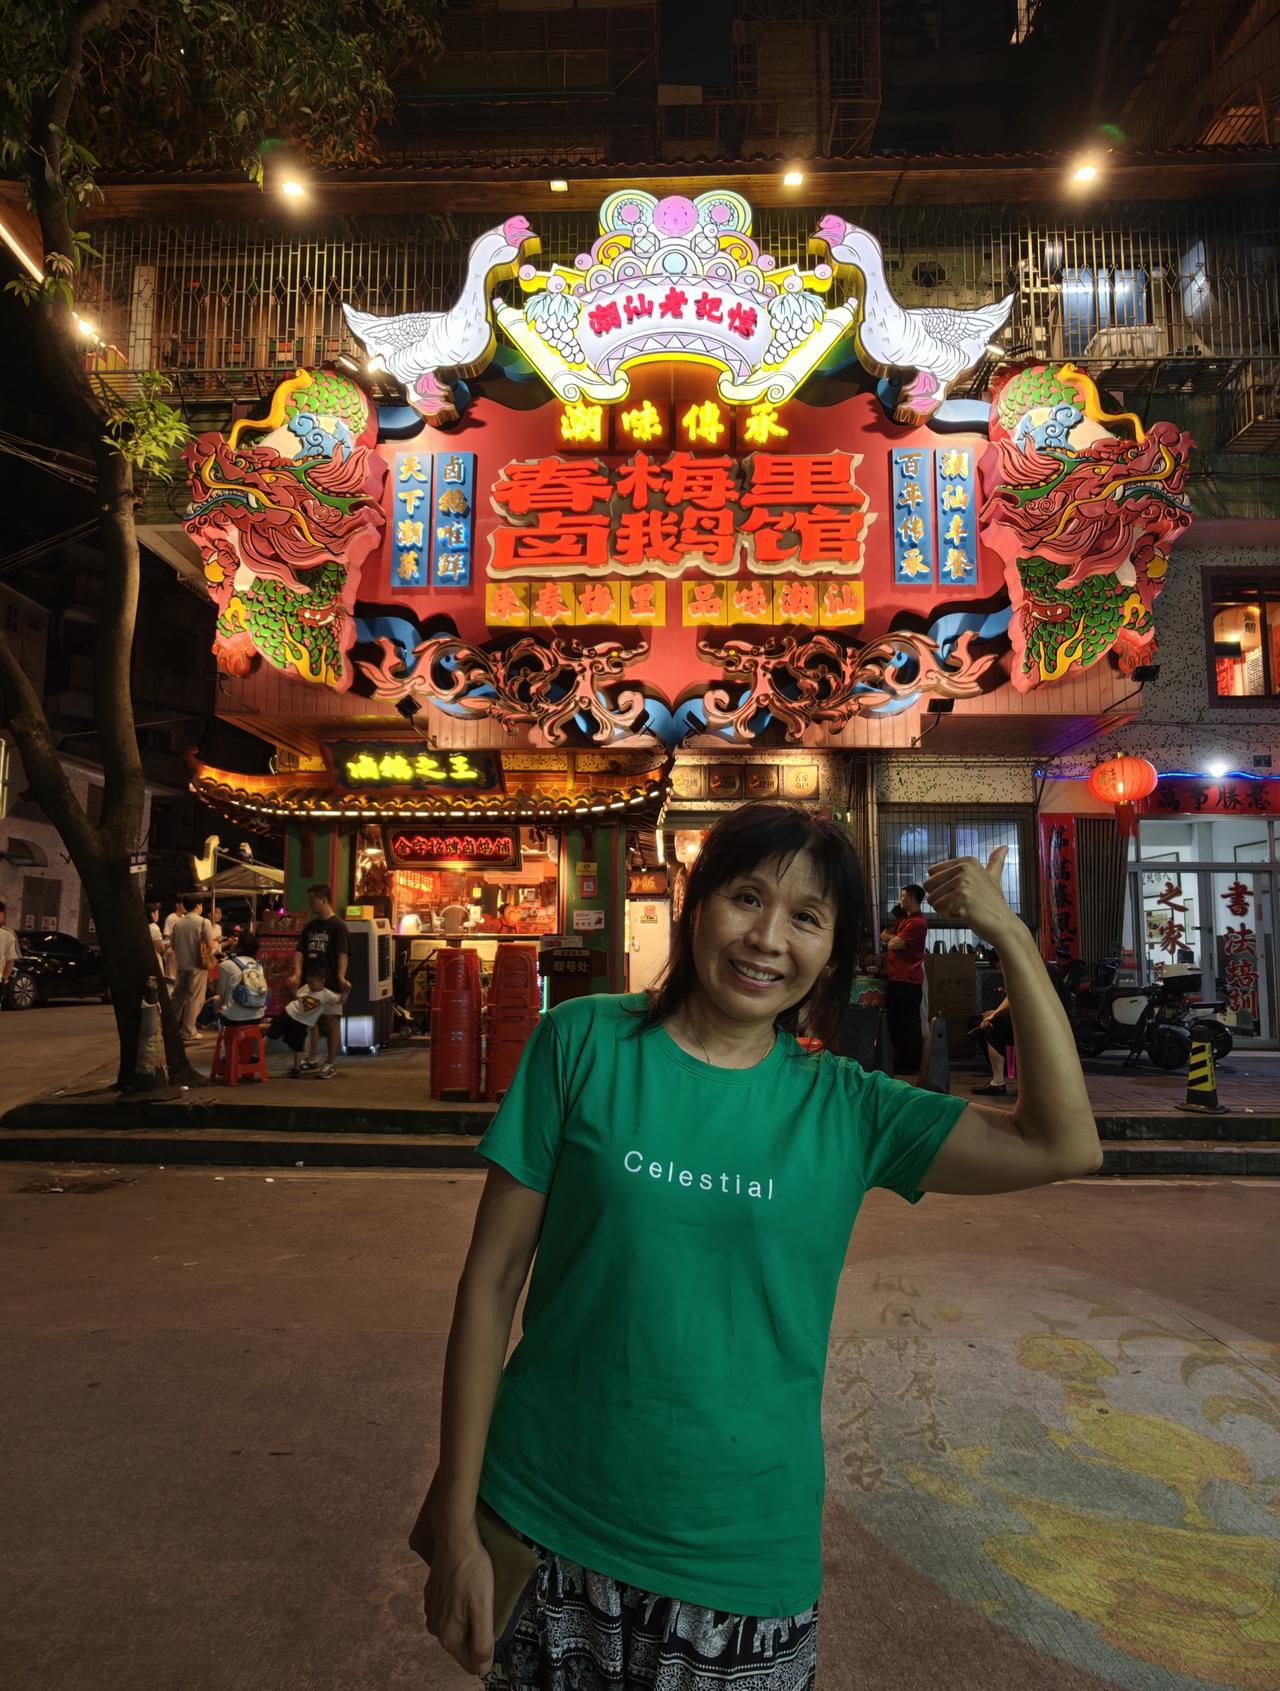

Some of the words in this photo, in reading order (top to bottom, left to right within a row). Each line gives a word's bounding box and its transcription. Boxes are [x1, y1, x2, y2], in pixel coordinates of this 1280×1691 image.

[494, 451, 867, 513] 春梅里
[493, 504, 866, 569] 卤鹅馆
[687, 581, 860, 618] 品味潮汕
[624, 1150, 773, 1200] Celestial
